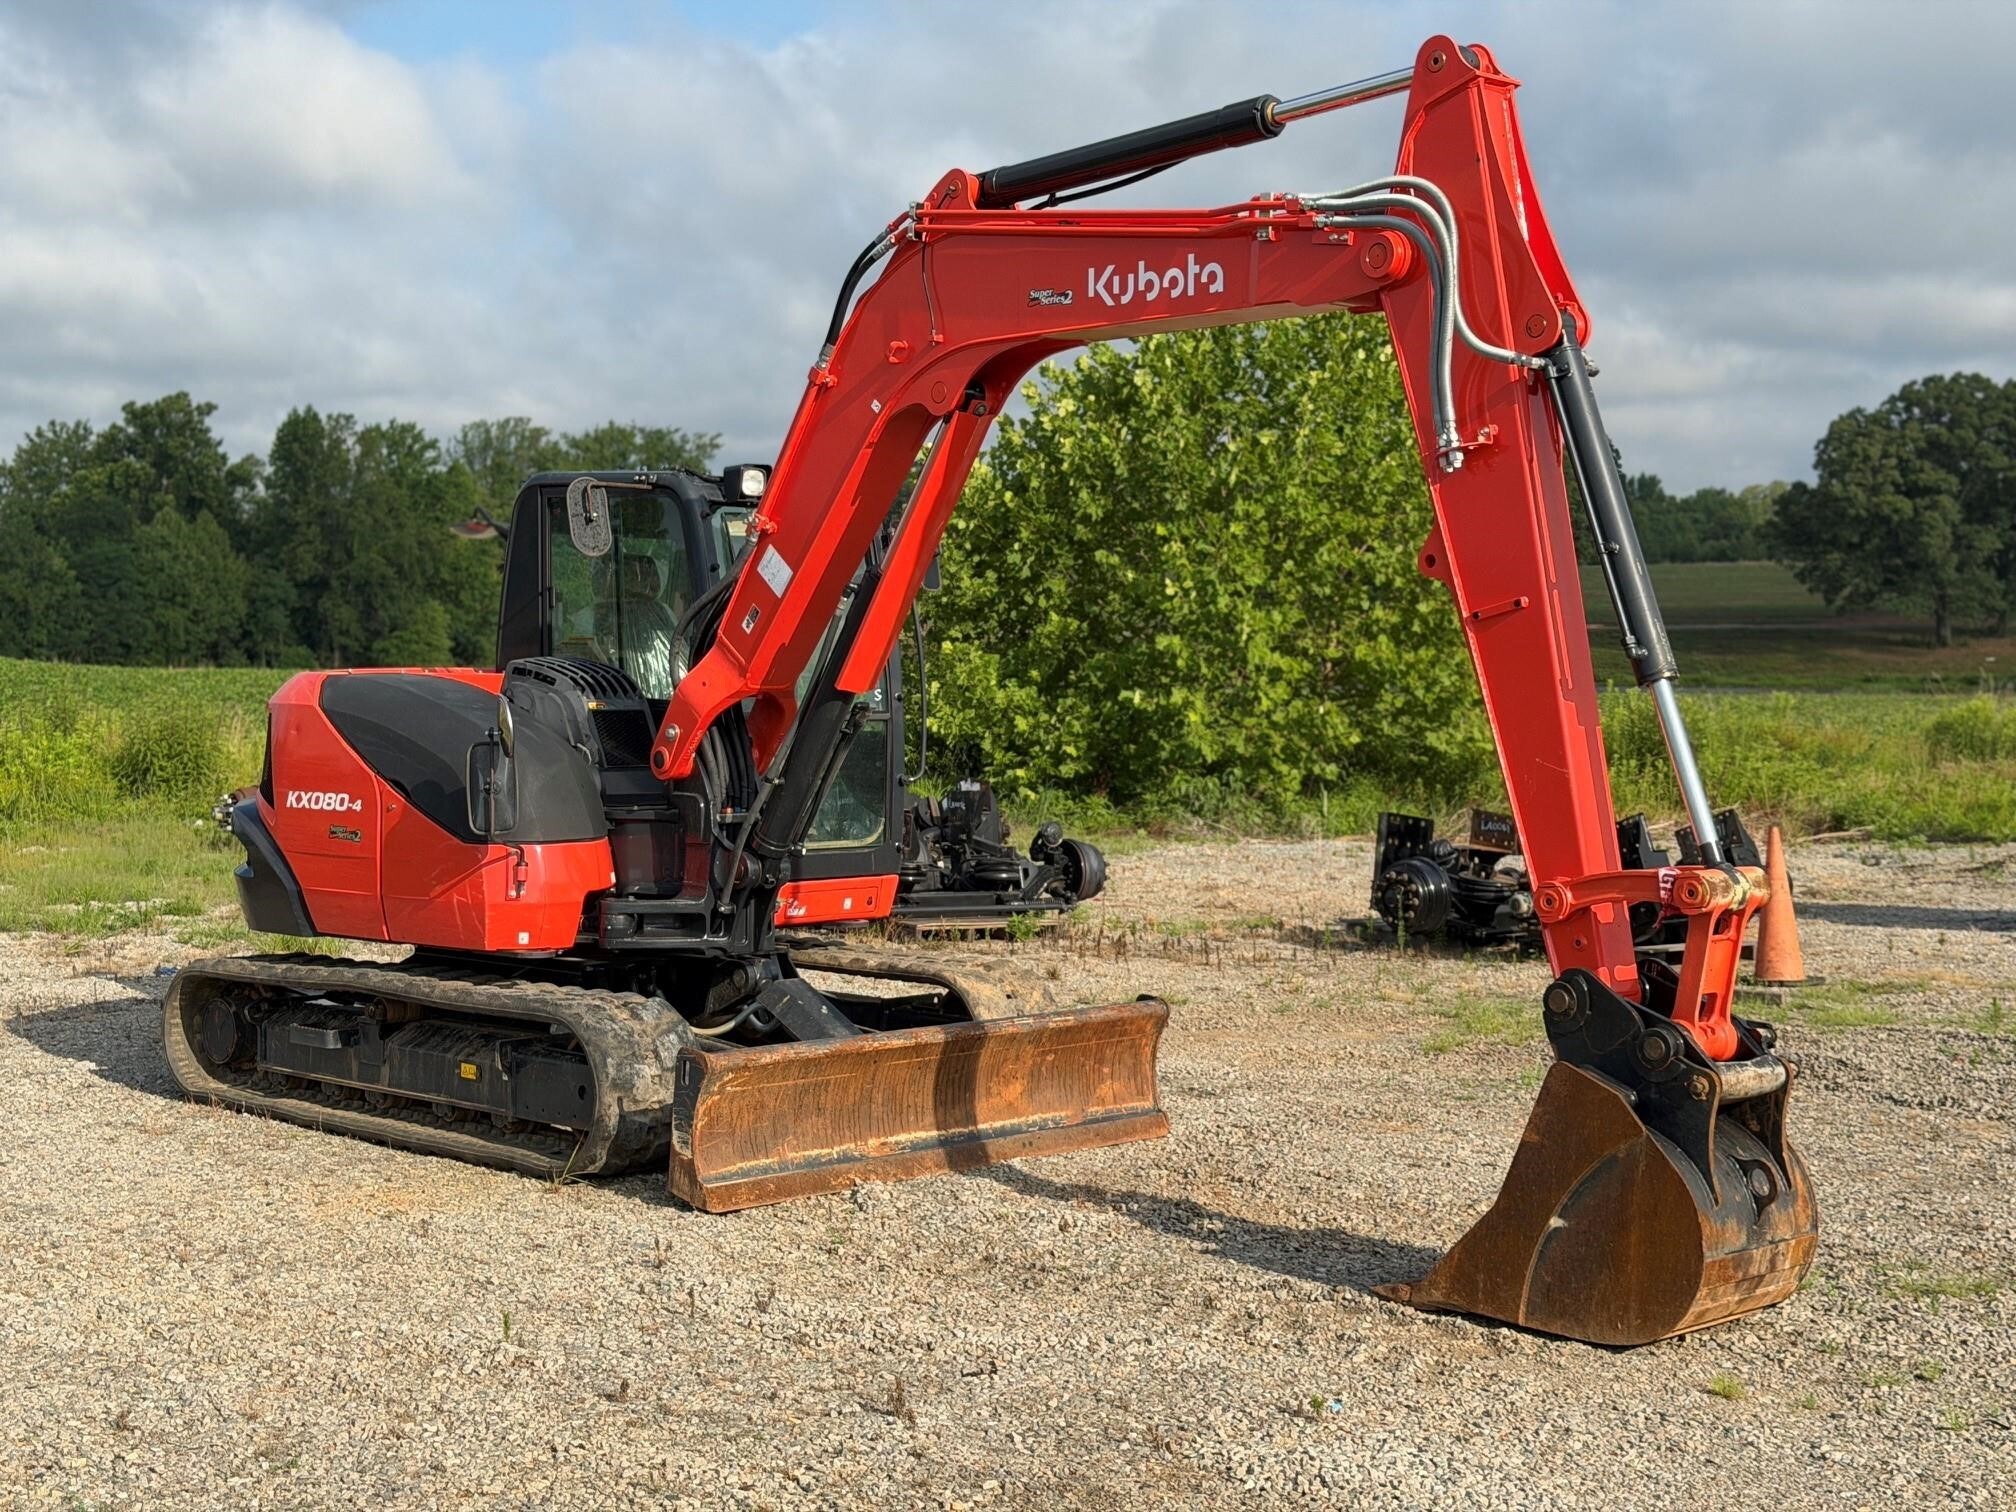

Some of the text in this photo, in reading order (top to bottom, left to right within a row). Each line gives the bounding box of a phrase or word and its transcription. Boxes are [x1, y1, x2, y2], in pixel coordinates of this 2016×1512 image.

[1087, 253, 1224, 307] Kubota
[1029, 289, 1054, 300] Super
[286, 790, 363, 812] KX080-4
